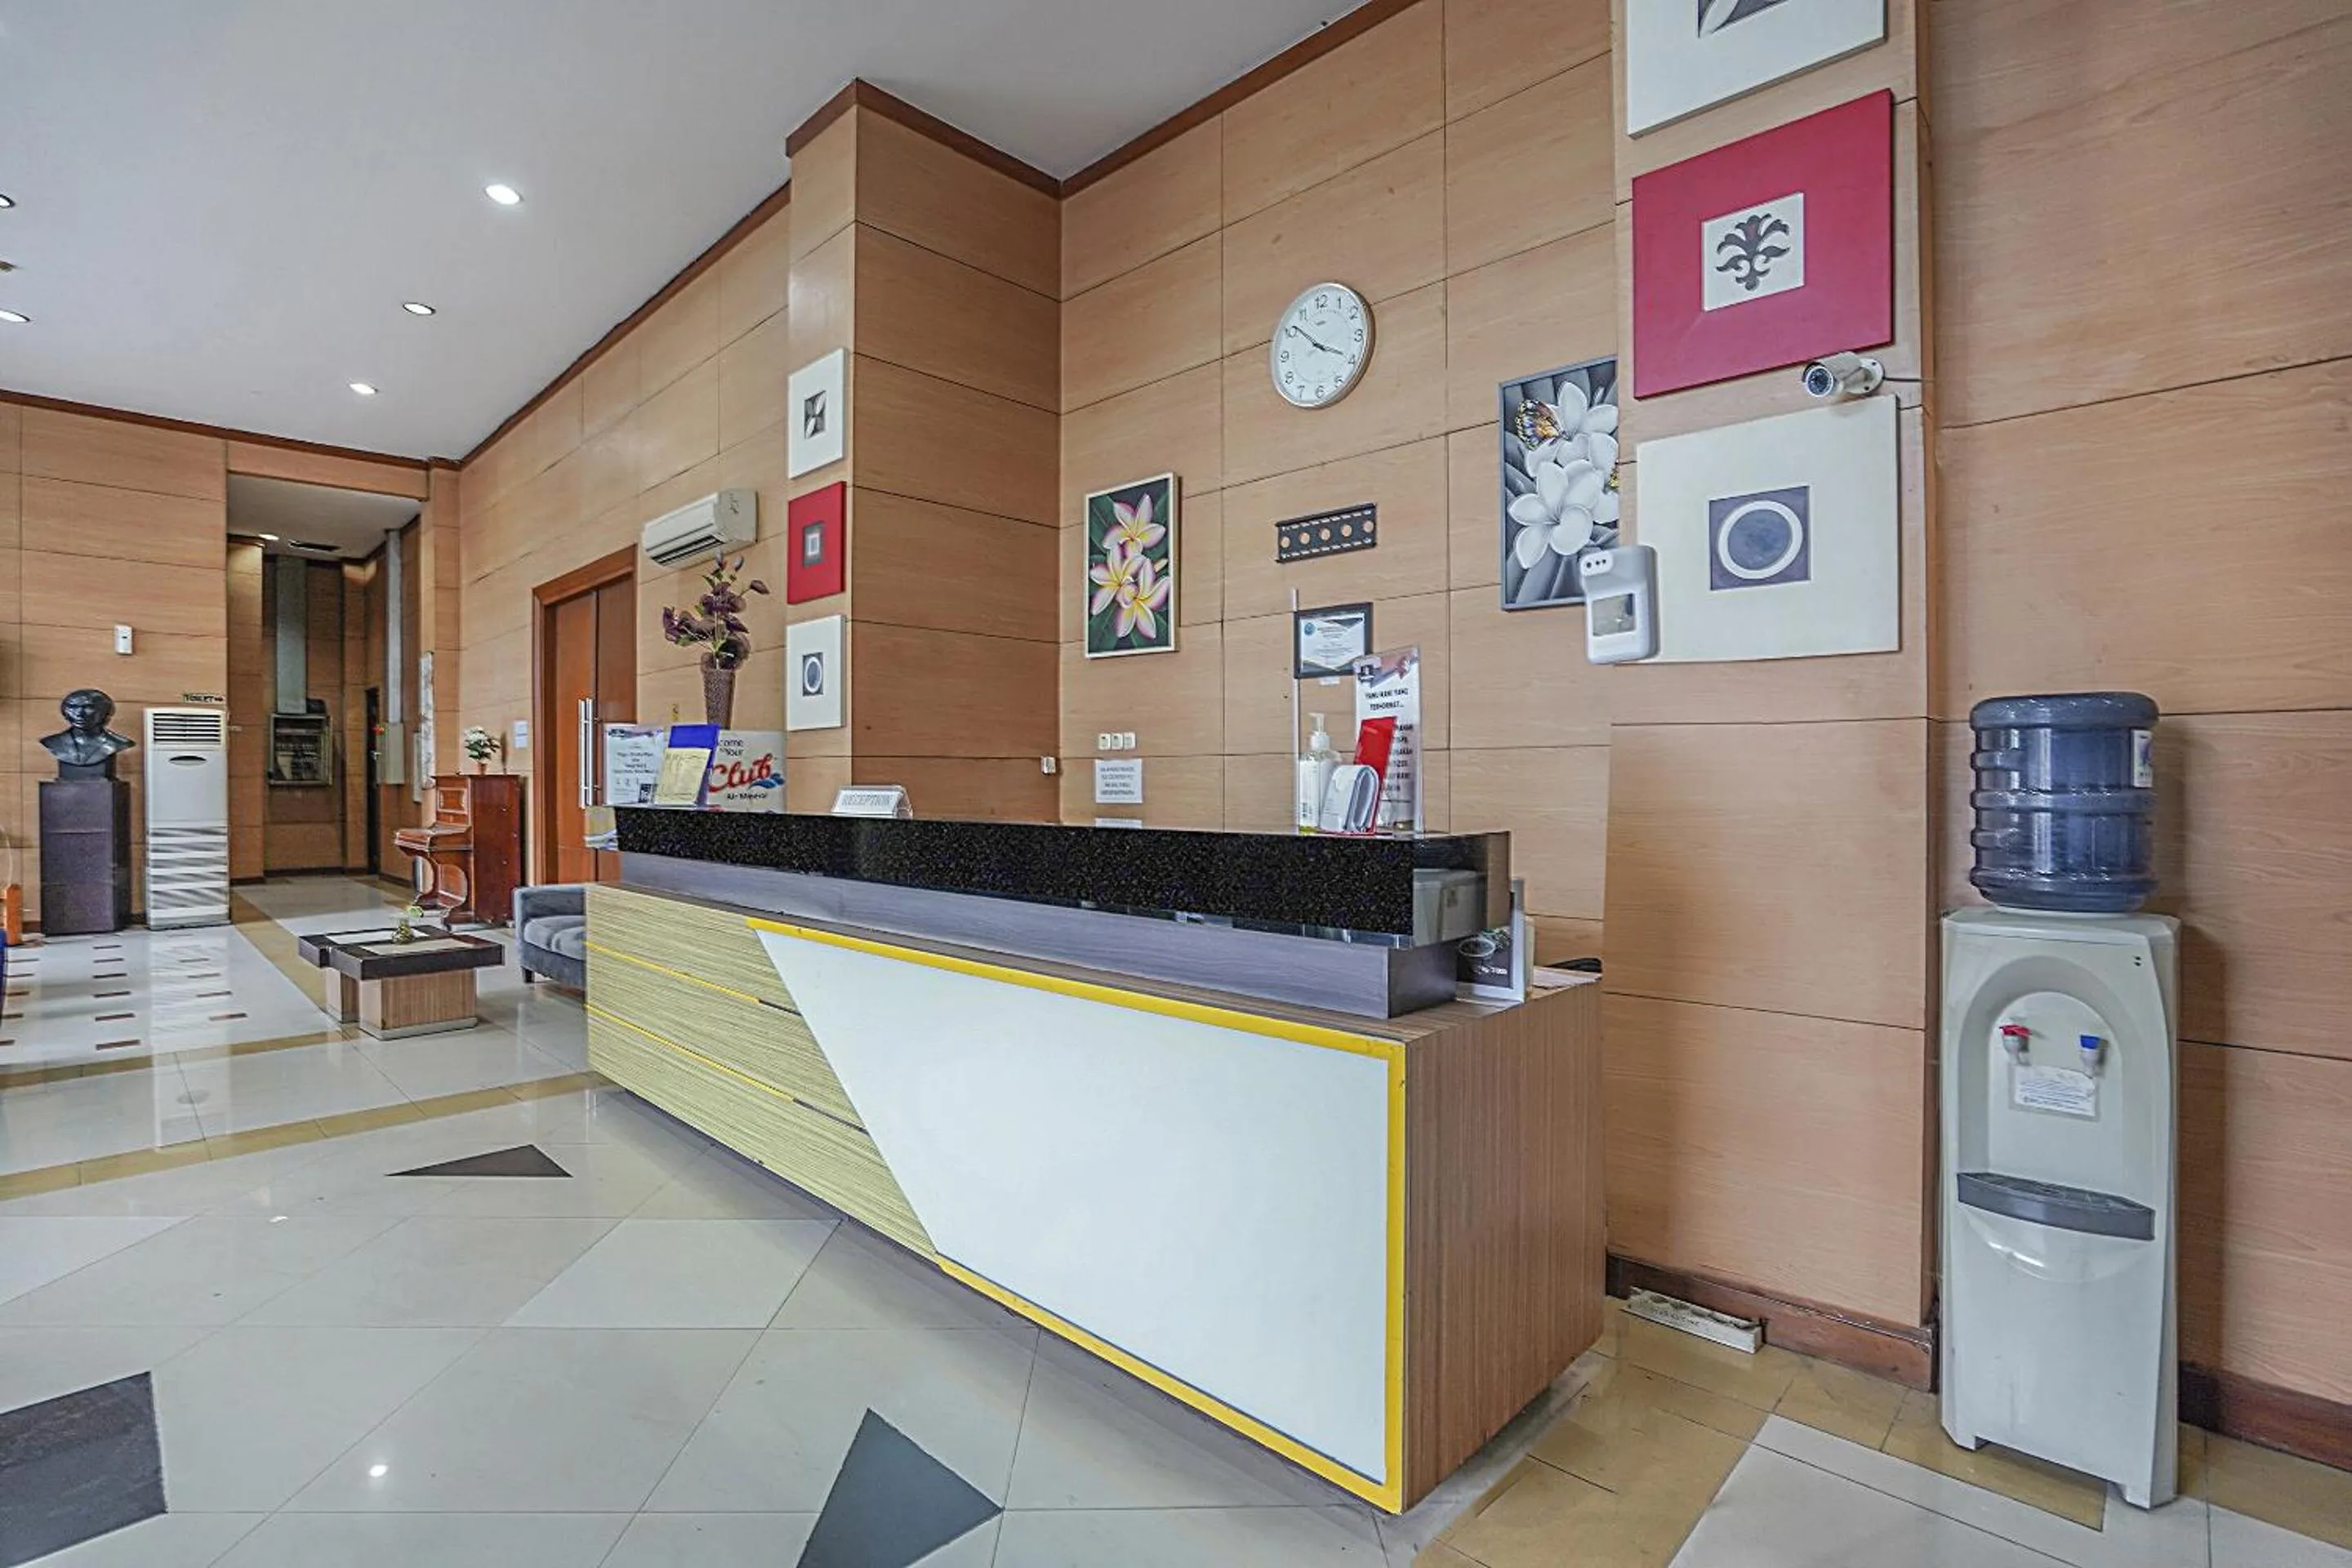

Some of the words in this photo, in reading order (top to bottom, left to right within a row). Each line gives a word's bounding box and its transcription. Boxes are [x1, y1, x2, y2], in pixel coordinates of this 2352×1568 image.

[1314, 295, 1328, 309] 12
[1348, 306, 1359, 320] 2
[1353, 329, 1363, 342] 3
[1280, 350, 1290, 363] 9
[1348, 354, 1356, 365] 4
[1285, 371, 1294, 385] 8
[1297, 385, 1305, 399] 7
[1315, 385, 1325, 399] 6
[708, 751, 773, 793] Club
